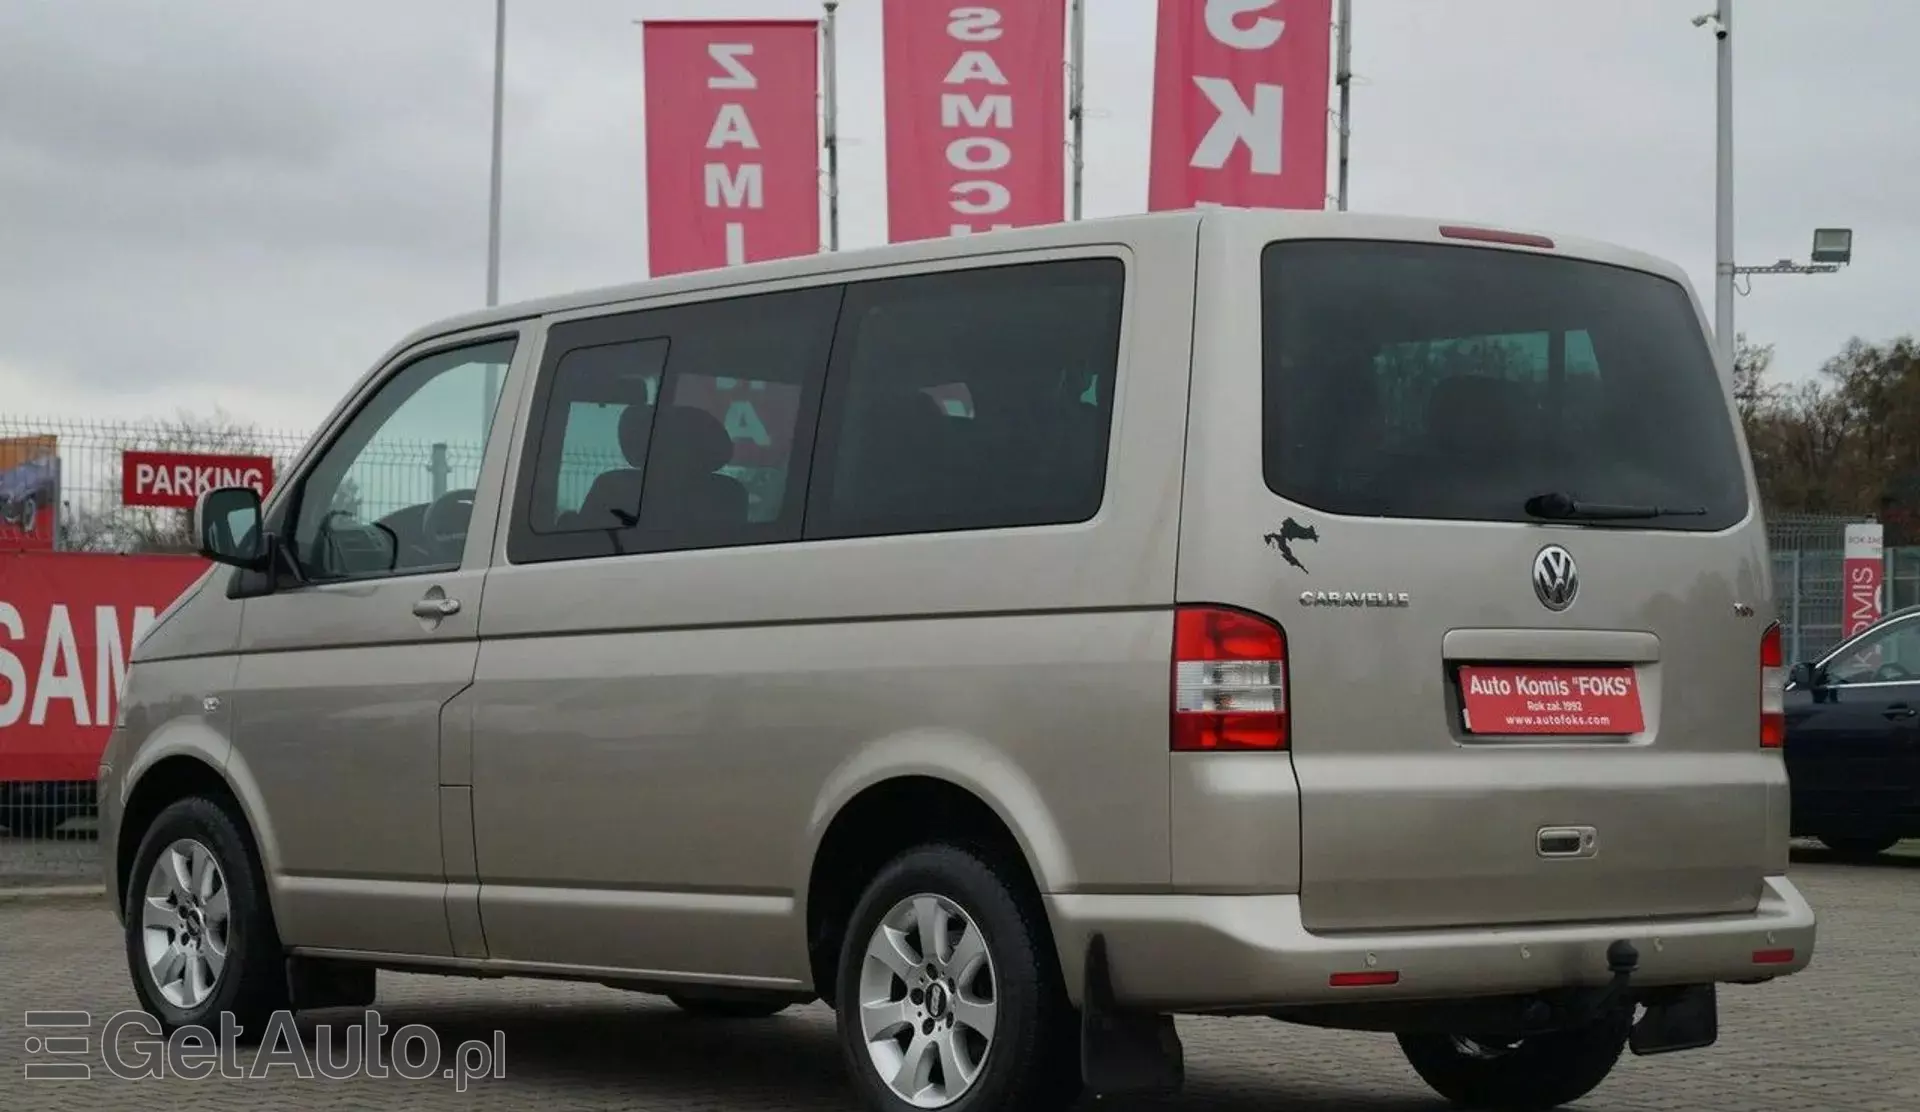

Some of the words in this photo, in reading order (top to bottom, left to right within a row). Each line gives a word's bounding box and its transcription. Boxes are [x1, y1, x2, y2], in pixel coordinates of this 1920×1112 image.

[136, 464, 263, 496] PARKING
[1299, 590, 1410, 608] CARAVELLE
[1470, 675, 1511, 695] Auto
[1516, 675, 1570, 696] Komis
[1572, 675, 1632, 696] "FOKS"
[1527, 701, 1545, 711] Rok
[1562, 701, 1583, 711] 1992
[1505, 715, 1611, 726] www.autofoks.com
